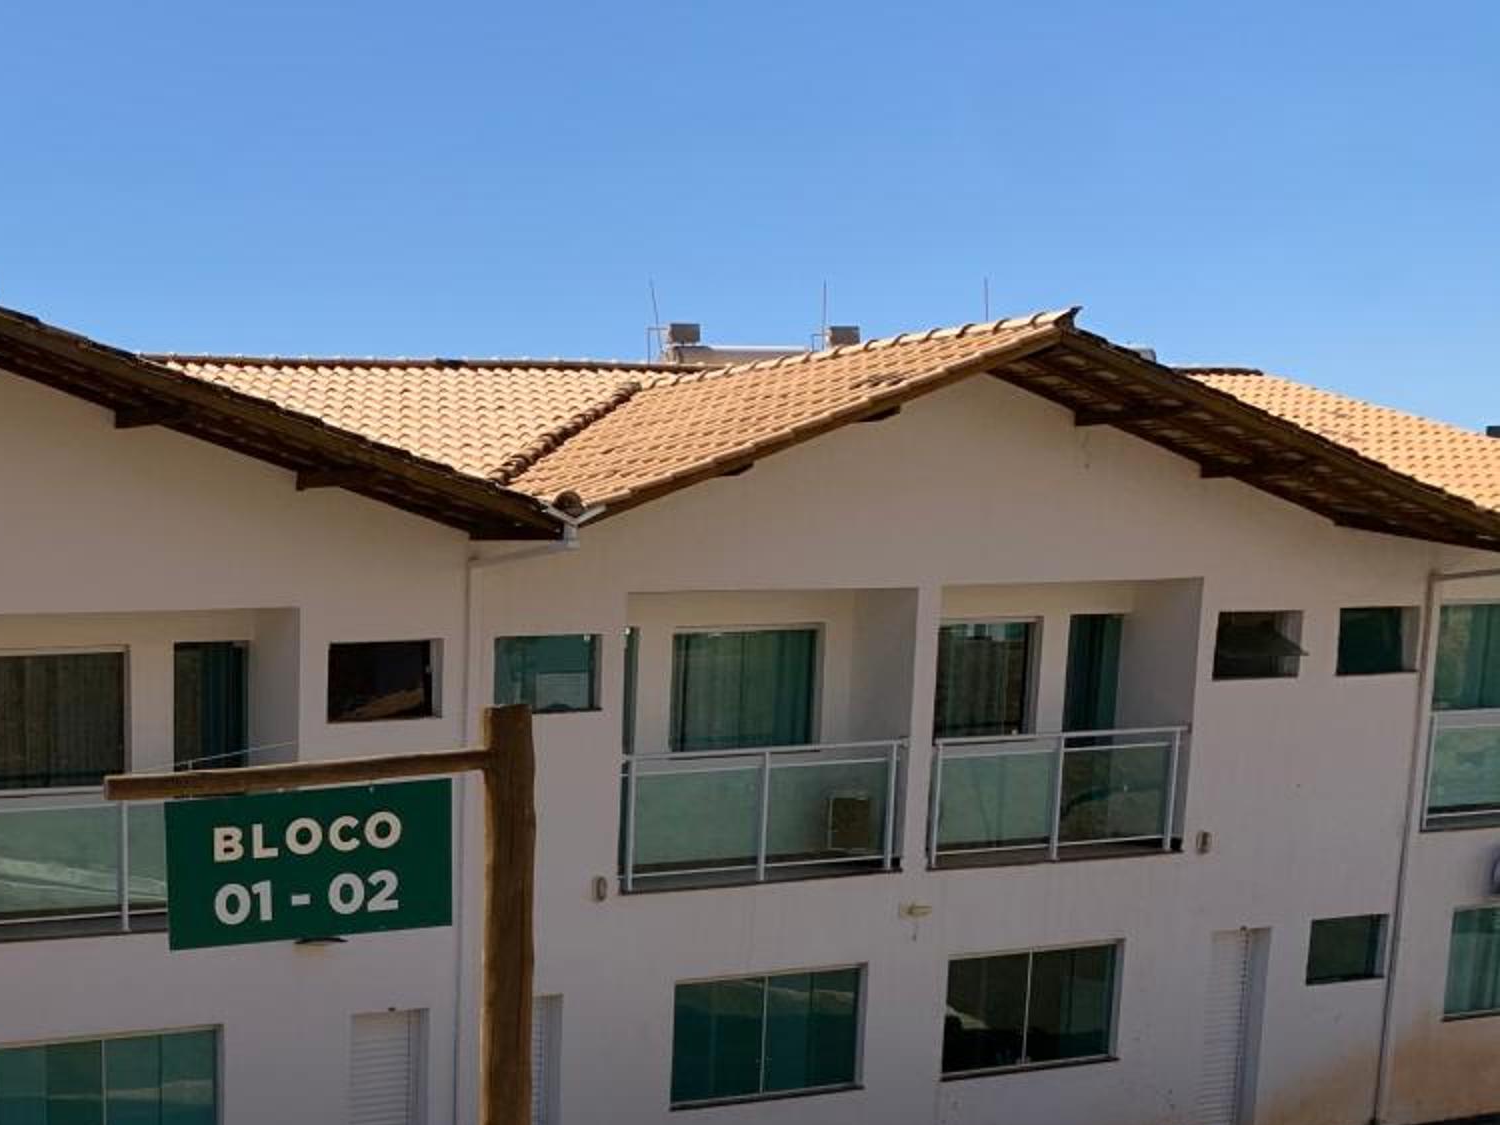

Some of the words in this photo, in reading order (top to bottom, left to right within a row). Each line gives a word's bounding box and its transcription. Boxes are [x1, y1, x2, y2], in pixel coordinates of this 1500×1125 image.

[213, 811, 402, 863] BLOCO
[214, 880, 273, 925] 01
[291, 893, 311, 907] -
[328, 869, 399, 915] 02
